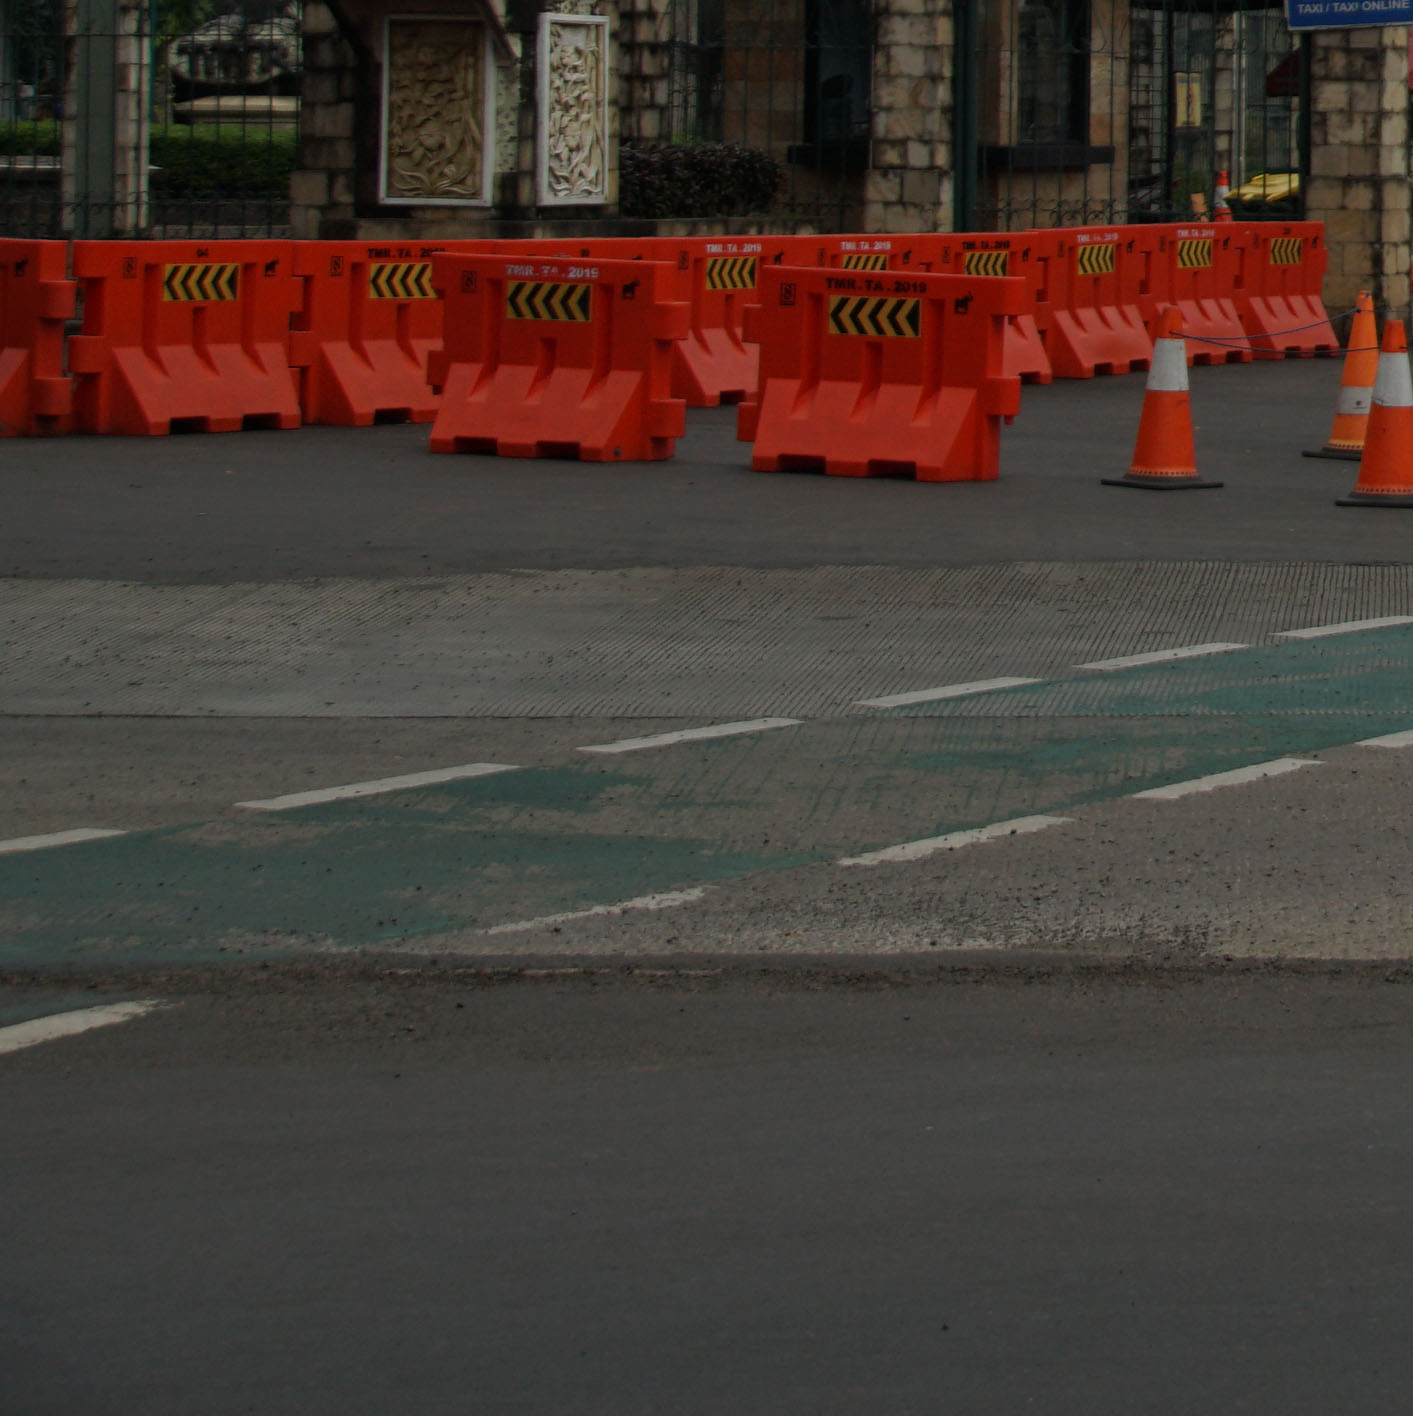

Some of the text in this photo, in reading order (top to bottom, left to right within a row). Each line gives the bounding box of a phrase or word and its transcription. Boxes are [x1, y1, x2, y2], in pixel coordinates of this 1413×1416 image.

[1296, 3, 1324, 14] TAXI
[1333, 2, 1359, 12] TAXI
[1361, 0, 1411, 10] ONLINE
